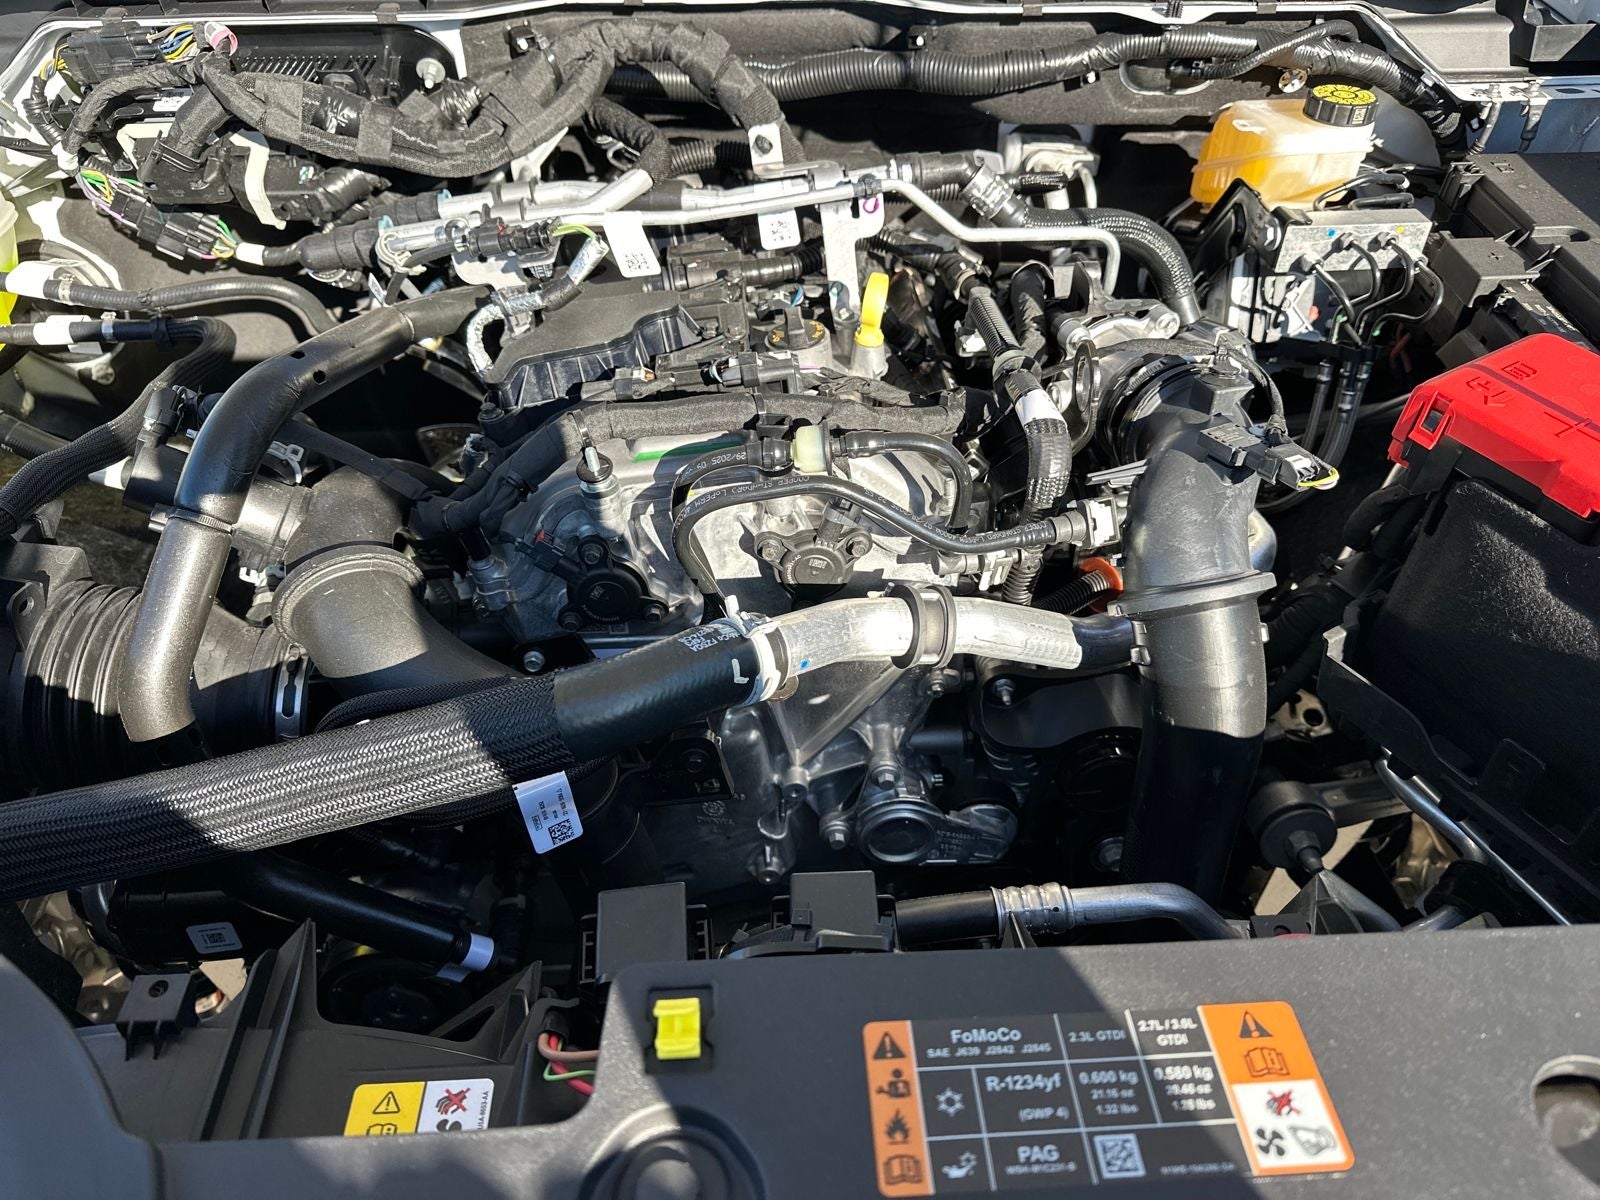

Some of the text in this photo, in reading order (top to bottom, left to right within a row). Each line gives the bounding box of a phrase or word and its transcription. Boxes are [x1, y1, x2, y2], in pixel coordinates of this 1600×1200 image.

[731, 658, 750, 685] L
[1137, 1019, 1165, 1032] 2.7L
[950, 1027, 1022, 1044] FoMoCo
[1068, 1029, 1126, 1043] 2.3L GTDI
[1156, 1033, 1189, 1046] GTDI
[926, 1048, 950, 1058] SAE
[955, 1046, 980, 1057] J639
[984, 1045, 1015, 1056] J2842
[1079, 1069, 1138, 1085] 0.600 kg
[1193, 1064, 1214, 1081] kg
[985, 1072, 1061, 1093] R-1234yf
[1196, 1083, 1213, 1094] oz
[1120, 1089, 1135, 1098] oz
[1119, 1103, 1138, 1114] lbs
[1195, 1098, 1216, 1111] lbs
[1017, 1144, 1060, 1163] PAG
